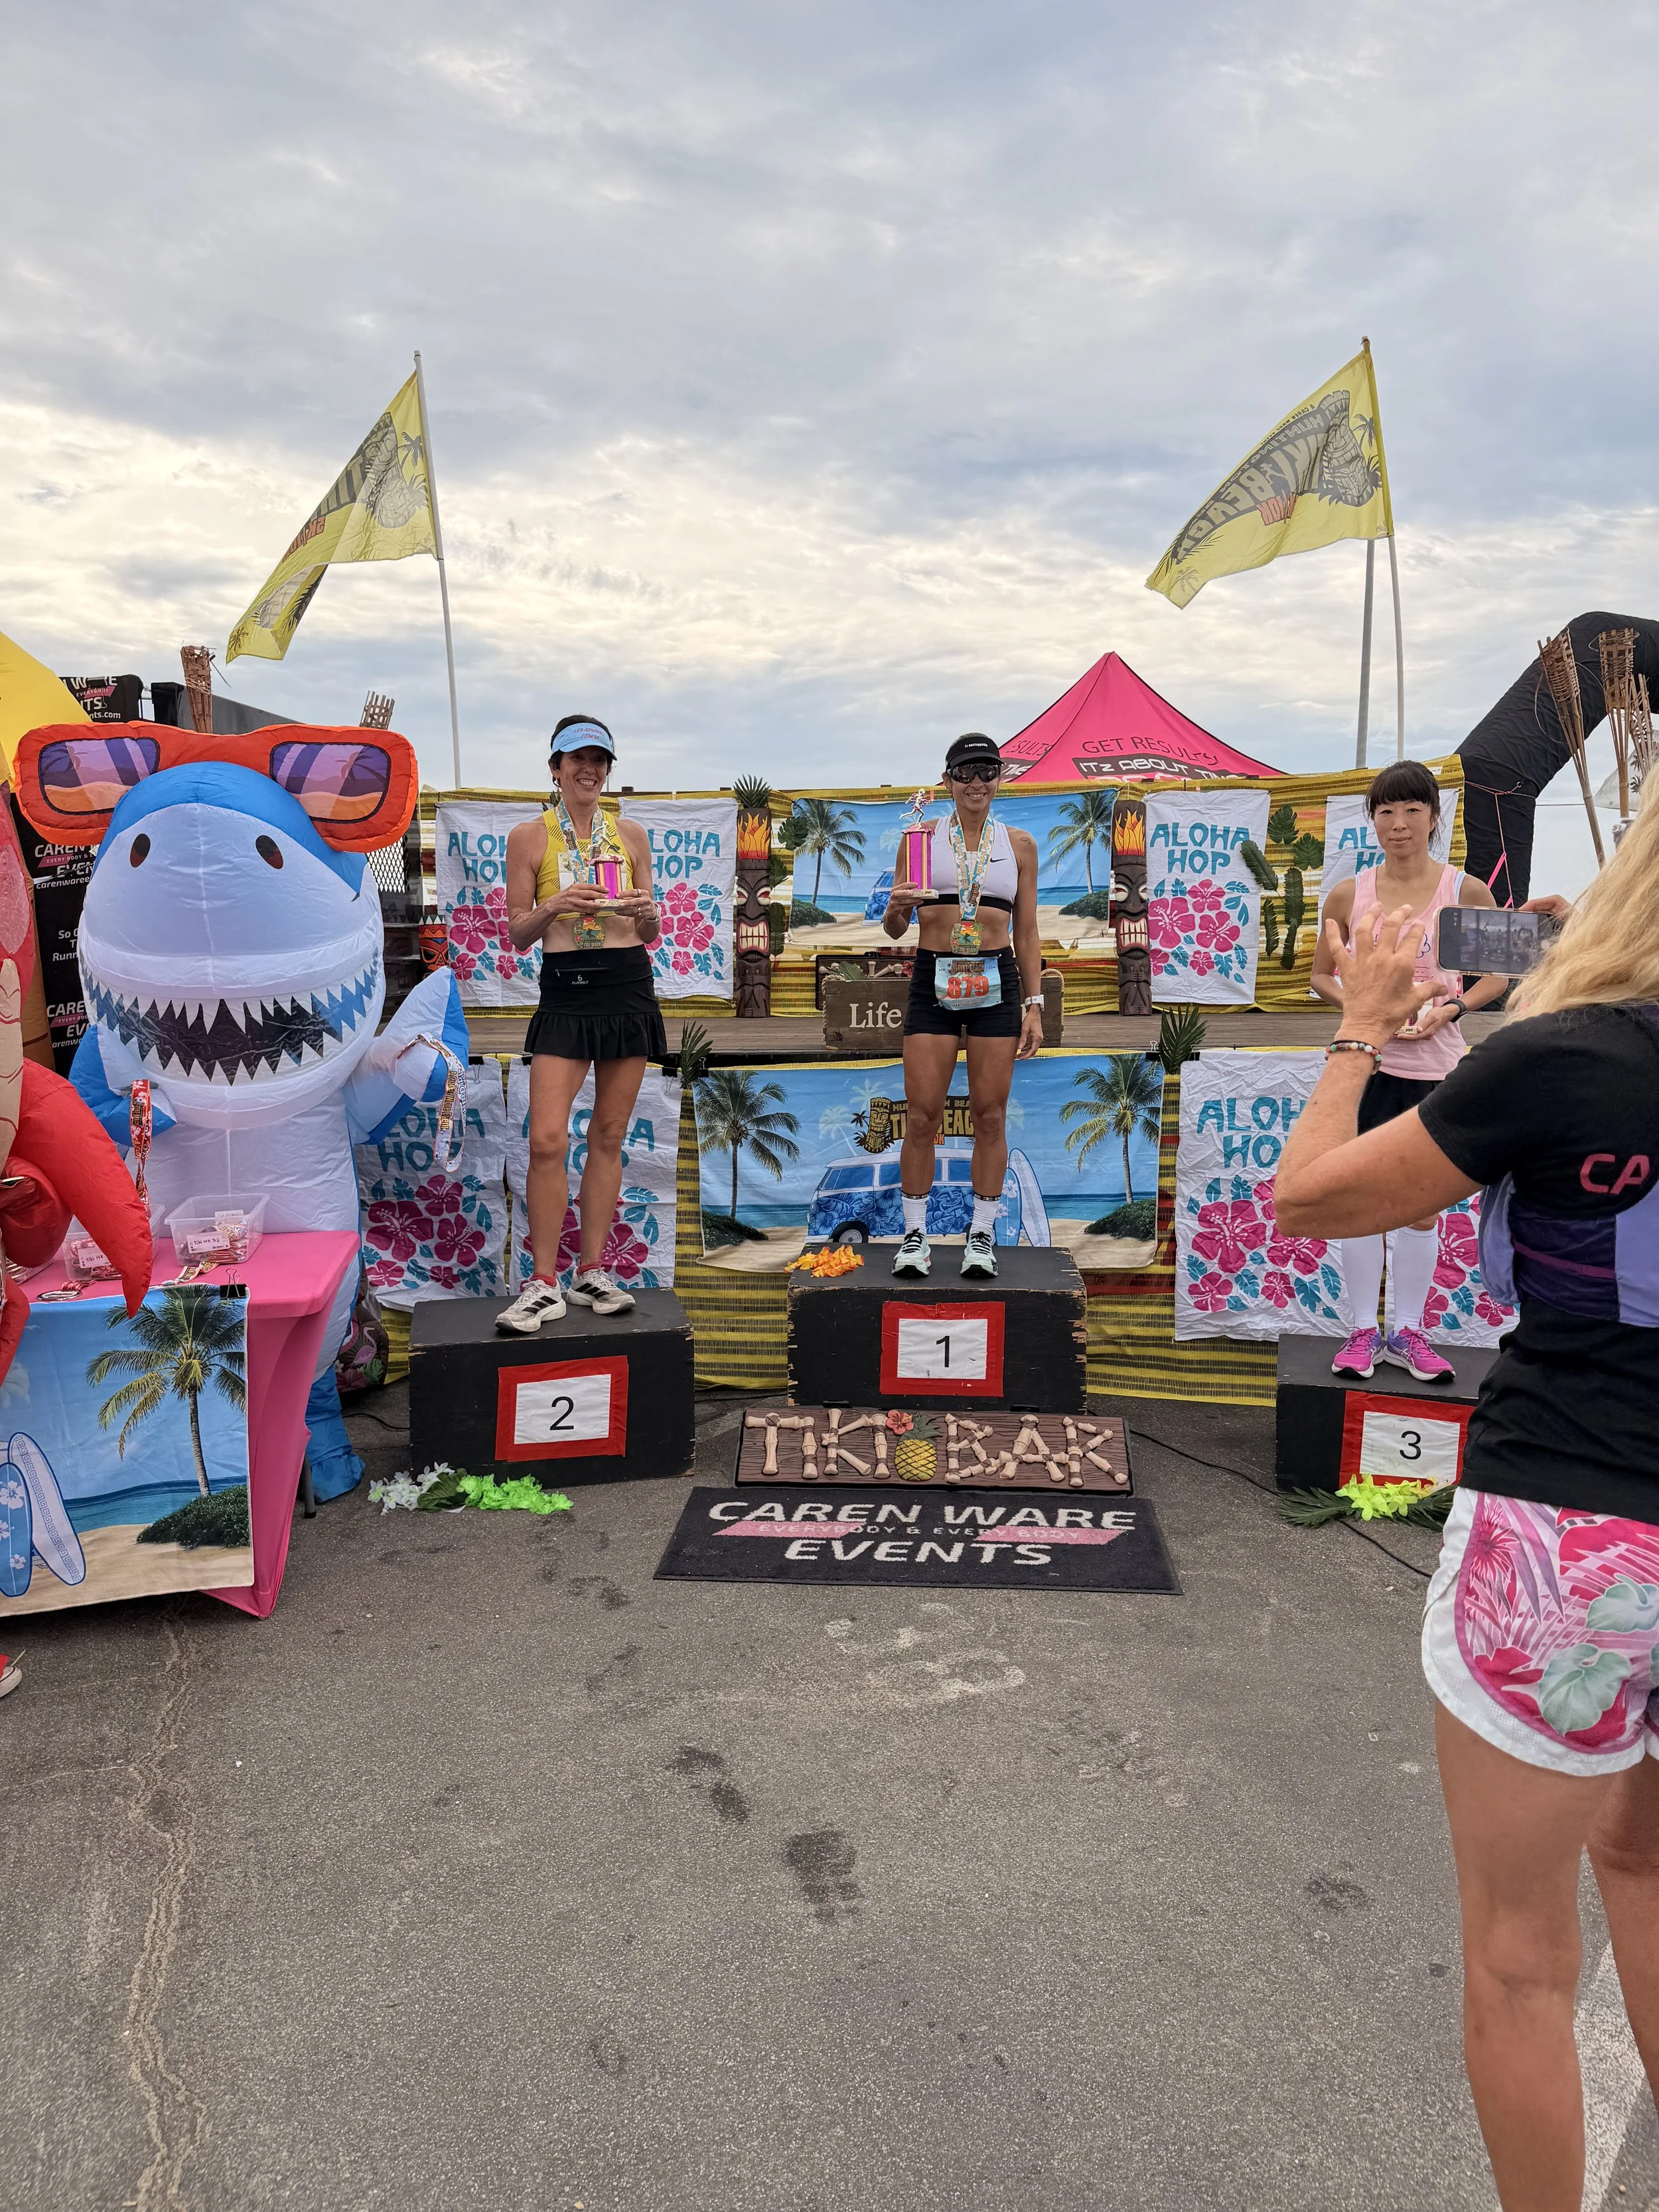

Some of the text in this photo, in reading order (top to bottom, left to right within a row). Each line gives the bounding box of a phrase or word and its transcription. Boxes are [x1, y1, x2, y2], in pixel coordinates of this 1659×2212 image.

[1082, 738, 1123, 753] GET
[1079, 762, 1115, 773] ITz
[1118, 759, 1189, 775] ABOUT
[648, 829, 720, 857] LOHA
[1149, 822, 1250, 850] ALOHA
[1168, 849, 1231, 875] HOP
[947, 975, 989, 999] 879
[849, 1002, 902, 1029] Life
[936, 1335, 950, 1368] 1
[549, 1396, 575, 1431] 2
[745, 1408, 1129, 1487] TIKI BAR
[1399, 1430, 1421, 1460] 3
[708, 1501, 1137, 1530] CAREN WARE
[906, 1526, 922, 1534] &
[784, 1538, 1052, 1566] EVENTS
